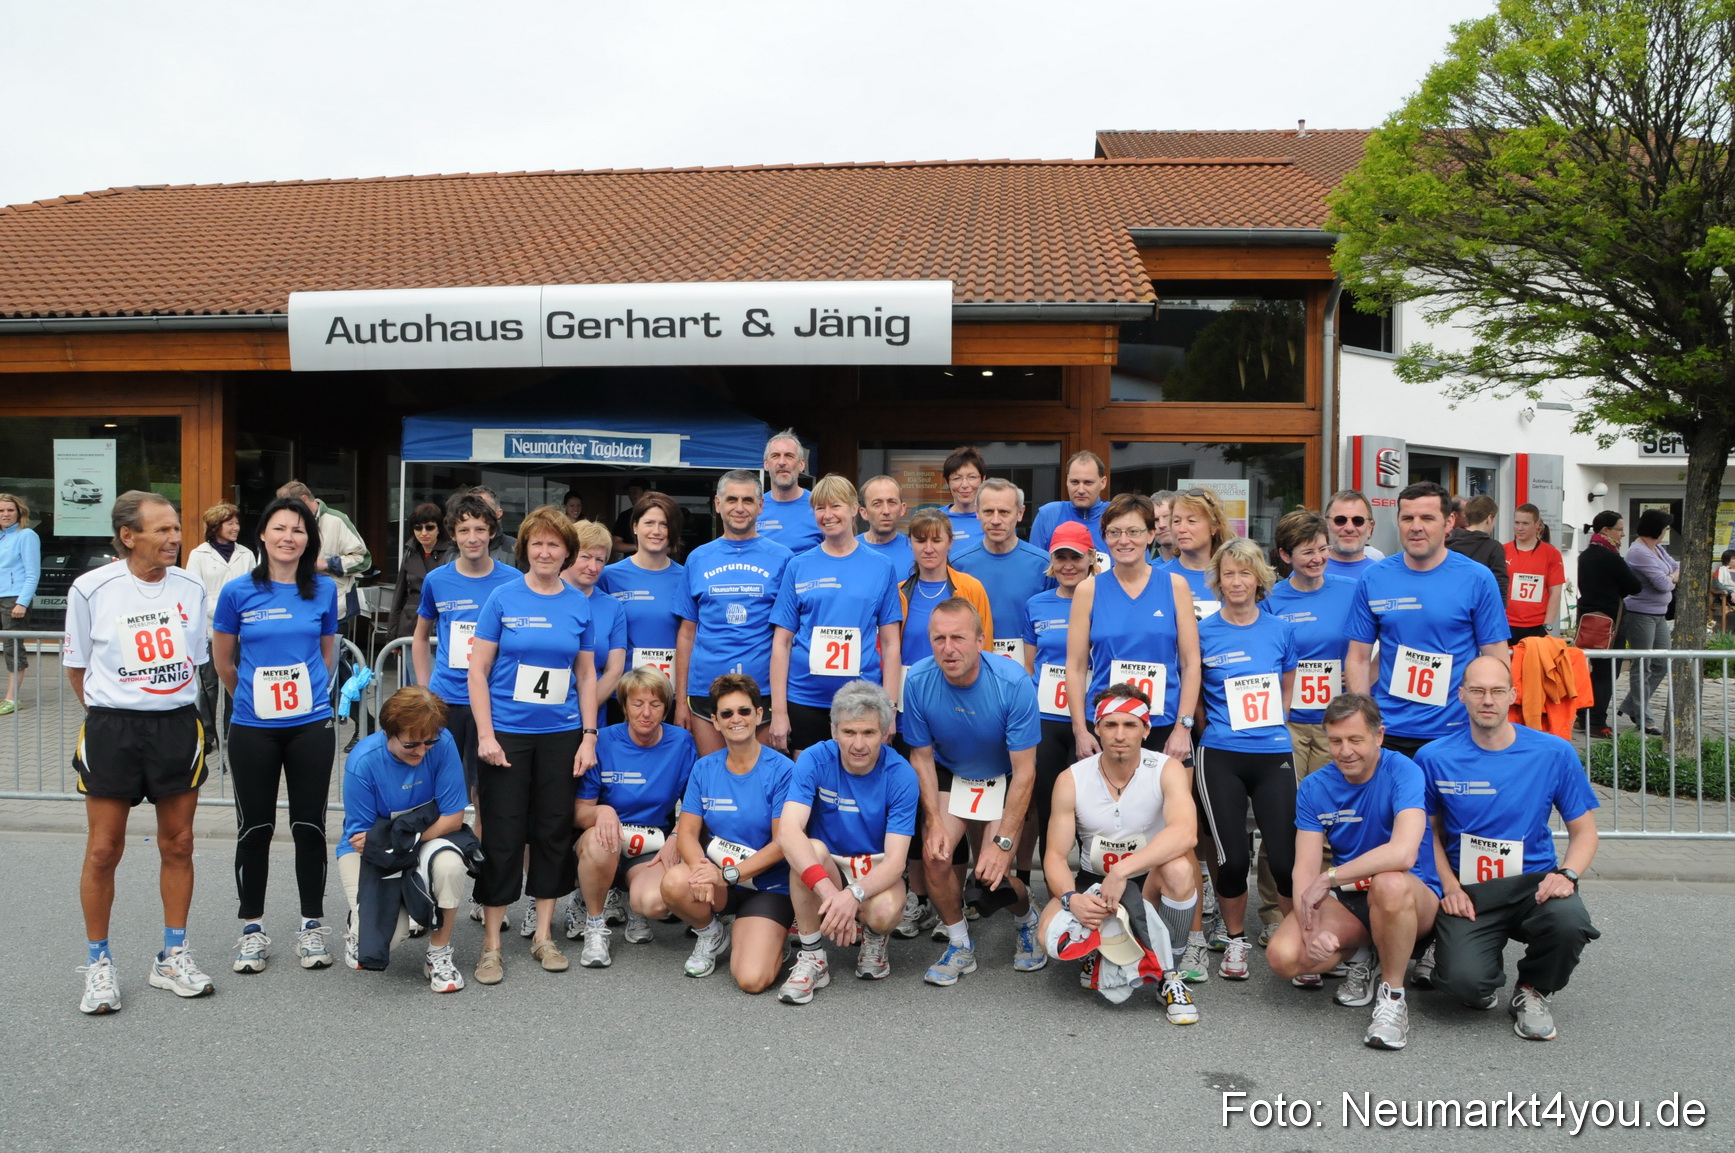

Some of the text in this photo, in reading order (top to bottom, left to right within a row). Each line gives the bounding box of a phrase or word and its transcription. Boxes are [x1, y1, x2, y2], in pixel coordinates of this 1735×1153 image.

[325, 307, 911, 346] Autohaus Gerhart & Jänig
[511, 437, 645, 458] Neumarkter Tagblatt
[1371, 498, 1397, 507] SEA
[703, 563, 770, 580] funrunners
[1519, 583, 1537, 599] 57
[127, 614, 157, 624] MEYER
[128, 621, 158, 629] WERBUNG
[135, 627, 174, 662] 86
[825, 641, 850, 670] 21
[1406, 651, 1430, 662] MEYER
[1120, 663, 1146, 671] MEYER
[533, 671, 550, 699] 4
[1234, 678, 1260, 687] MEYER
[1301, 676, 1331, 704] 55
[1407, 666, 1434, 697] 16
[270, 681, 299, 711] 13
[1242, 691, 1270, 723] 67
[970, 788, 984, 813] 7
[627, 834, 645, 856] 9
[718, 840, 742, 853] MEYER
[1100, 840, 1125, 848] MEYER
[1470, 838, 1498, 848] MEYER
[1476, 856, 1505, 883] 61
